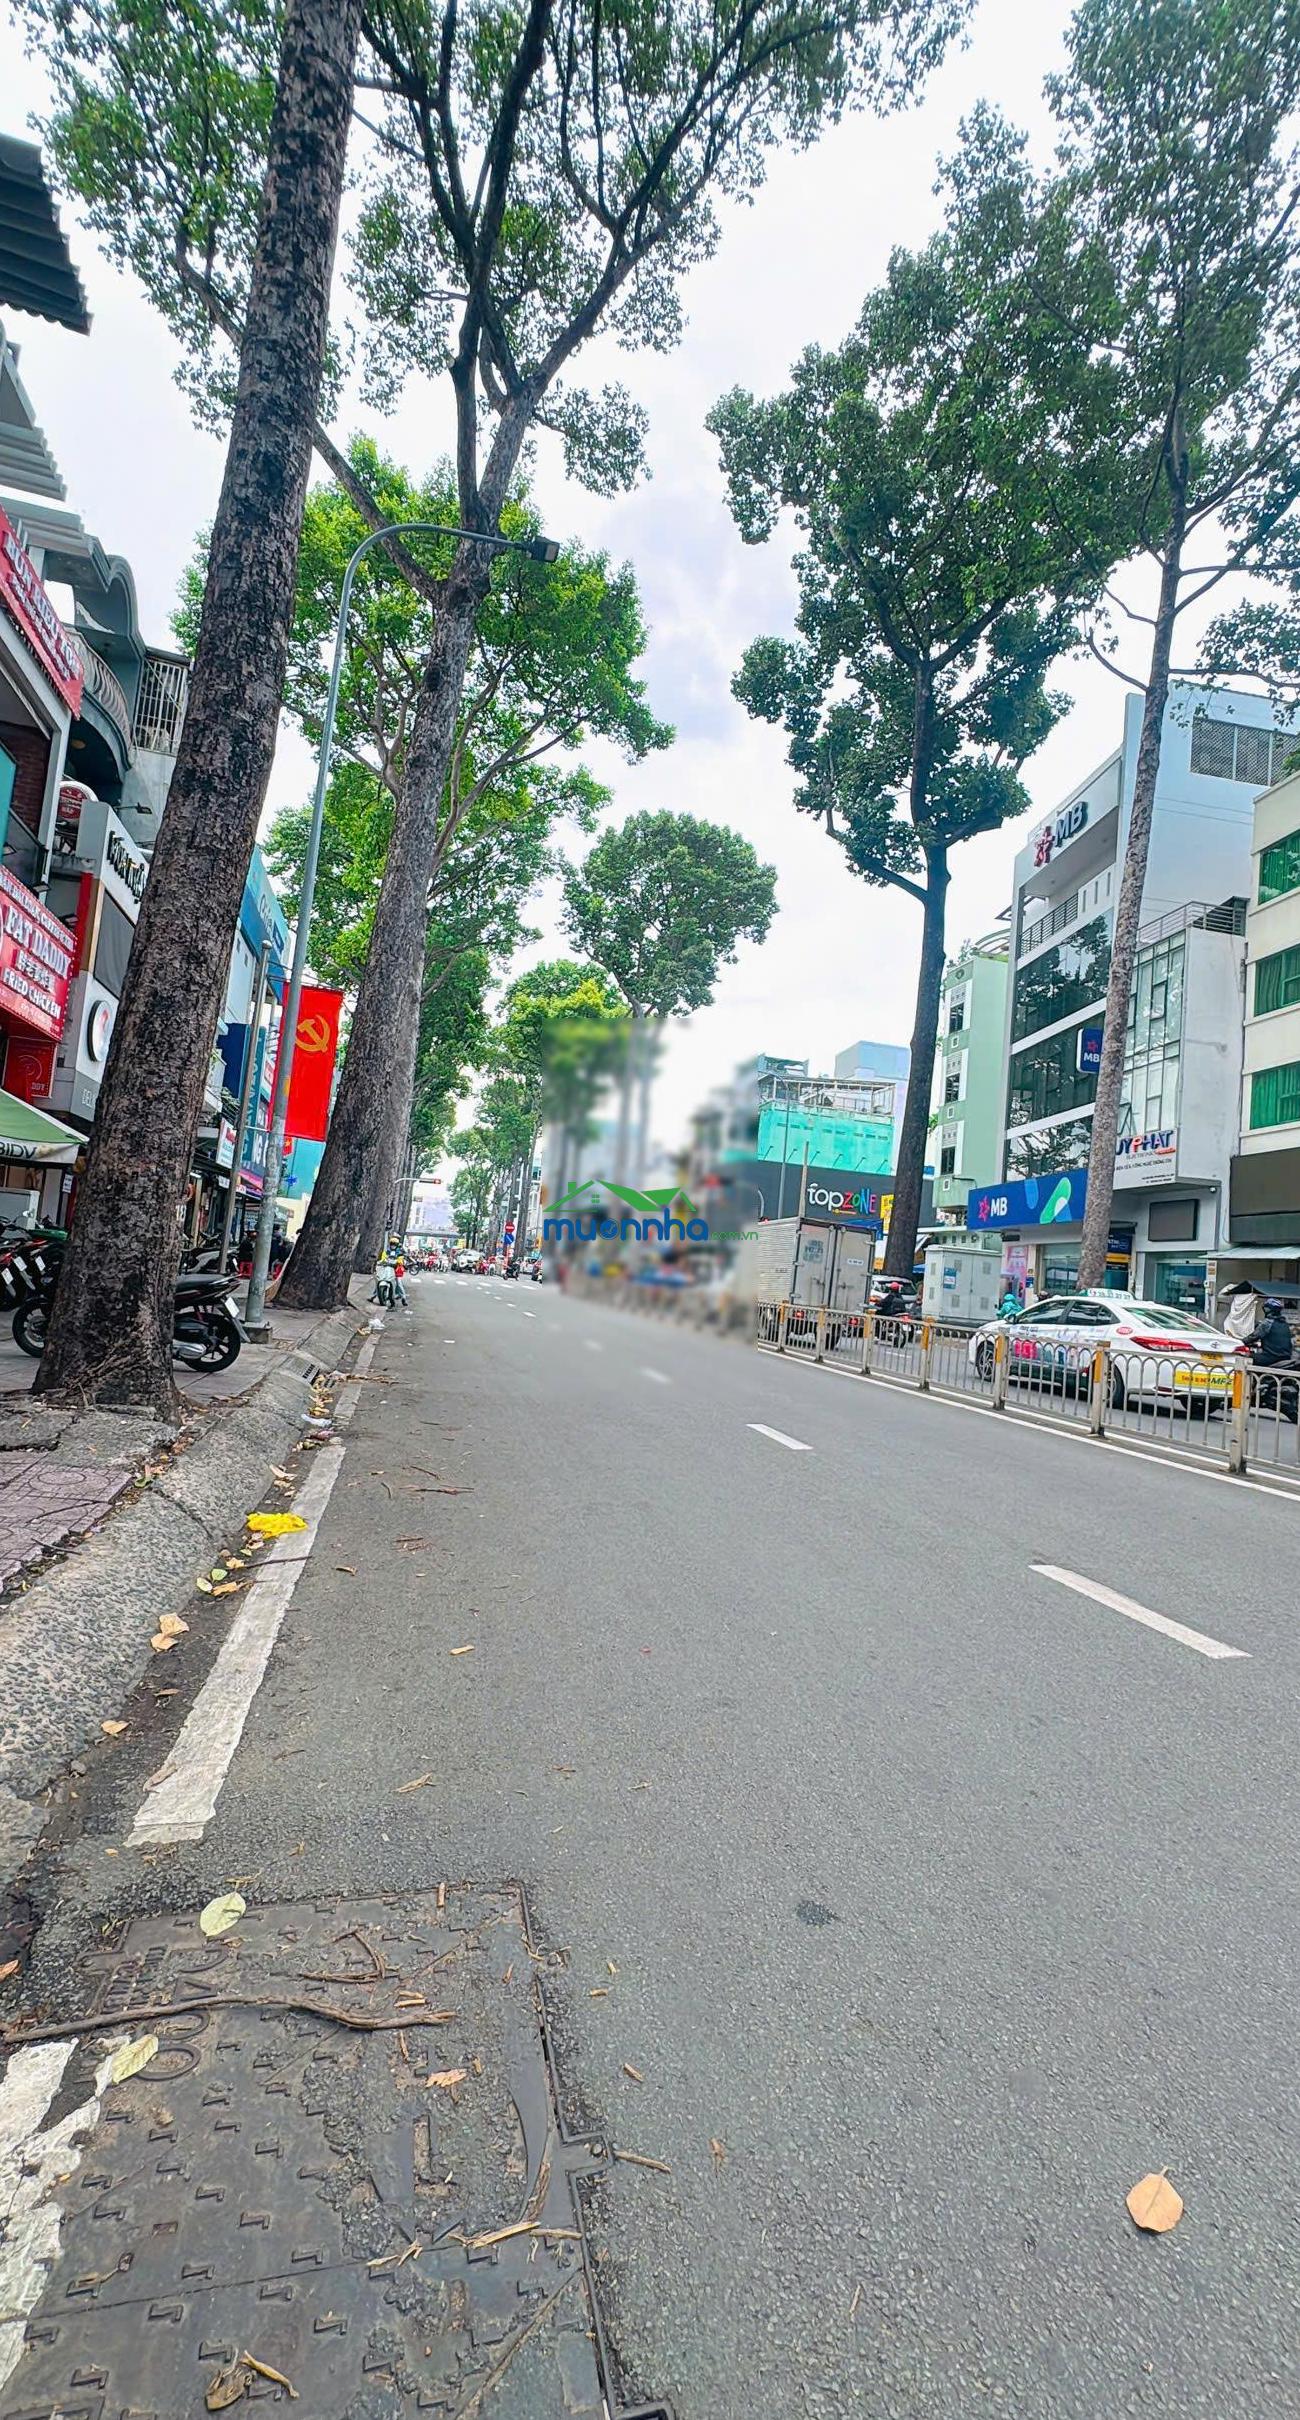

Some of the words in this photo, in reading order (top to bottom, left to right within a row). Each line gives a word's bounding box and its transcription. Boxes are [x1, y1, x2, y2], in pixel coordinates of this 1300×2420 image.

[1054, 801, 1089, 848] MB
[31, 928, 72, 980] DADDY
[3, 967, 29, 996] FRIED
[28, 987, 62, 1020] CHICKEN
[1083, 1052, 1101, 1064] MB
[990, 1196, 1008, 1218] MB
